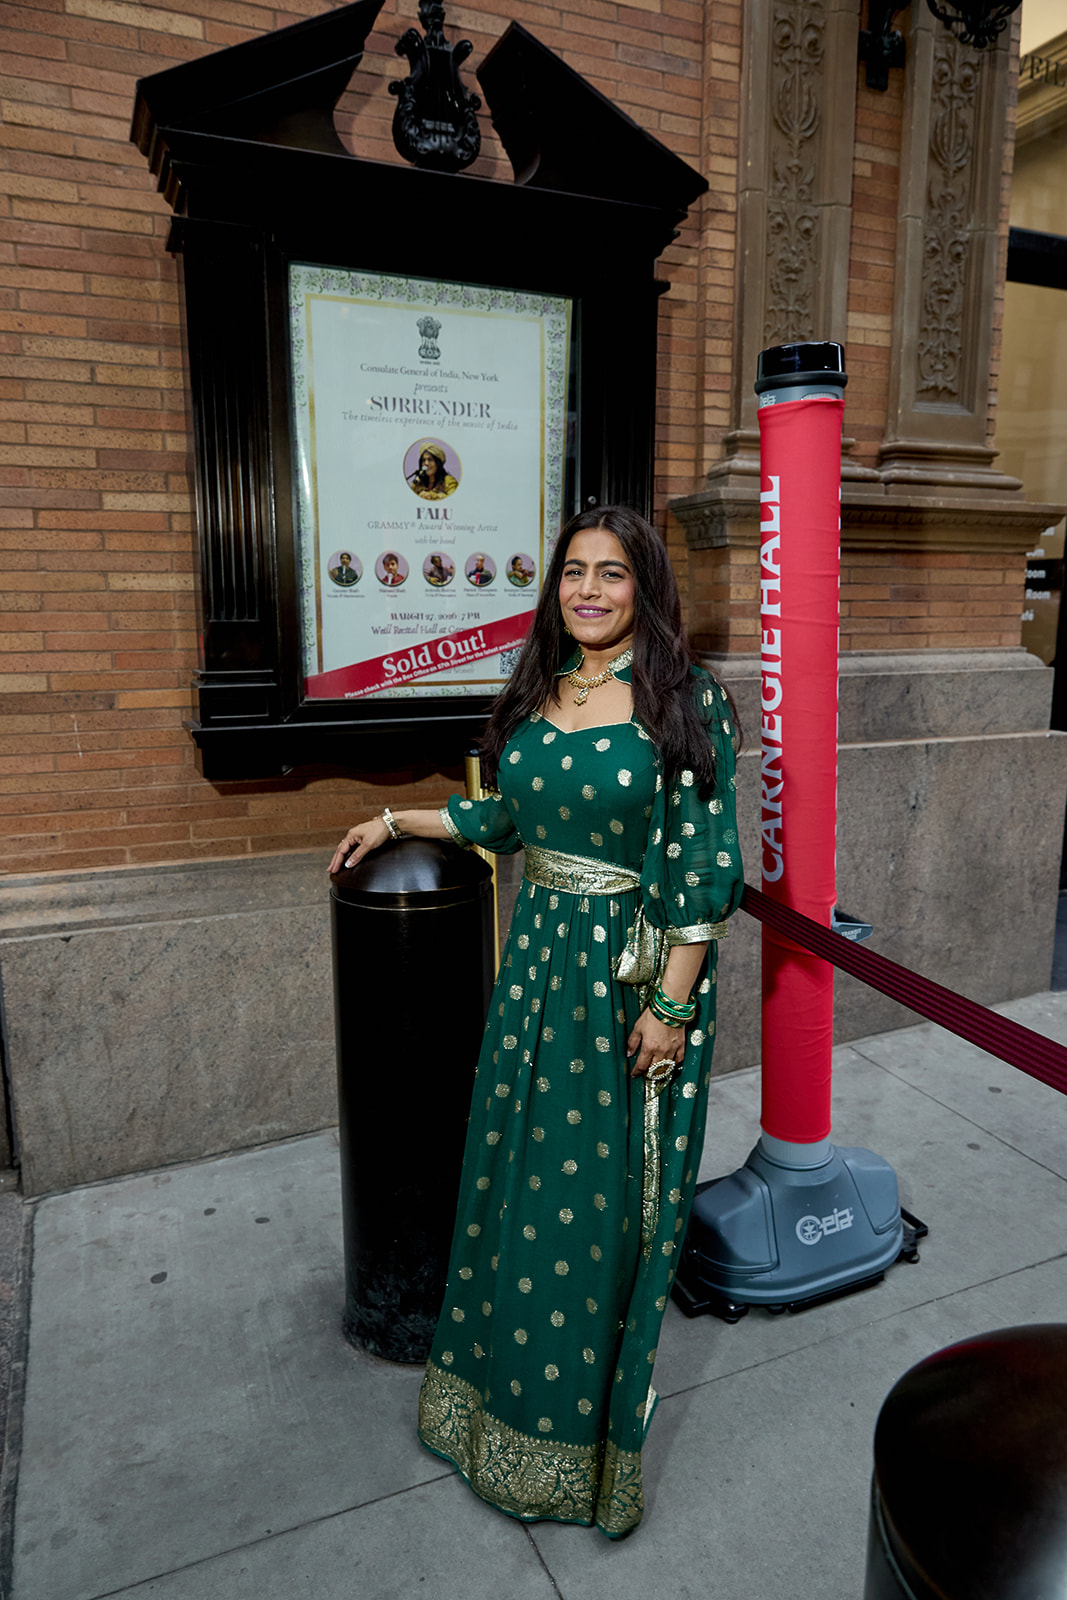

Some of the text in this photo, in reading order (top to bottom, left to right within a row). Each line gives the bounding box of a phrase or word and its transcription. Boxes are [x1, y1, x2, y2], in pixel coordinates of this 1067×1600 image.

[360, 363, 499, 382] Consulate General of India, New York
[414, 382, 448, 395] presents
[370, 396, 491, 418] SURRENDER
[341, 409, 518, 431] The timeless experience of the music of India
[416, 507, 453, 520] FALU
[418, 522, 442, 531] Award
[444, 523, 475, 534] Winning
[477, 524, 498, 532] Artist
[439, 536, 456, 545] band
[1025, 588, 1051, 600] Room
[390, 612, 424, 621] MARCH
[393, 624, 419, 635] Recital
[420, 624, 438, 634] Hall
[382, 629, 486, 678] Sold Out!
[344, 689, 364, 698] Please
[364, 683, 380, 693] check
[380, 679, 393, 688] with
[393, 676, 402, 684] the
[413, 668, 430, 677] Office
[437, 660, 450, 670] 57th
[450, 656, 467, 665] Street
[483, 646, 499, 655] latest
[760, 475, 785, 882] CARNEGIE HALL
